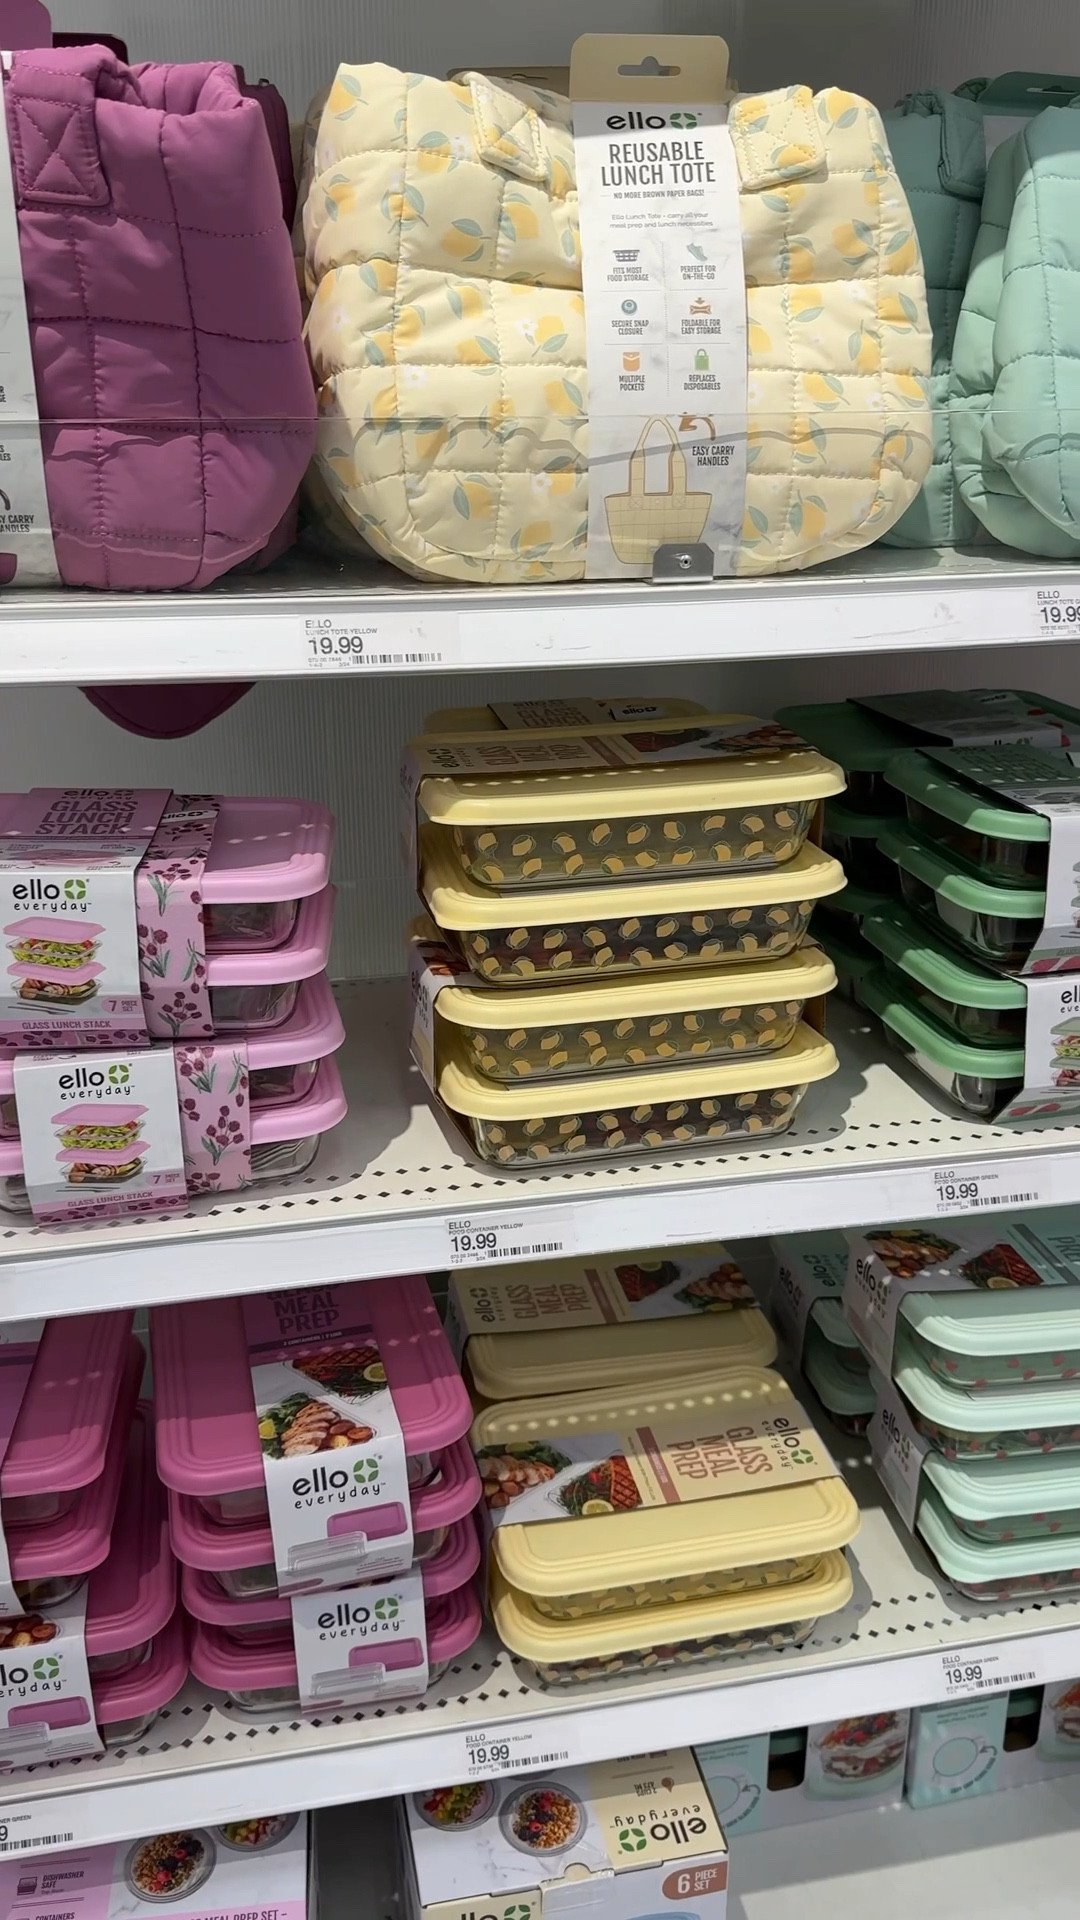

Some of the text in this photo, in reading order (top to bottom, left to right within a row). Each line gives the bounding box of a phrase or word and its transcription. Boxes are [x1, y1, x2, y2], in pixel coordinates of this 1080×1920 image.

[606, 112, 666, 130] ello
[609, 142, 705, 164] REUSABLE
[601, 162, 716, 187] LUNCH TOTE
[666, 190, 685, 198] PAPER
[686, 189, 705, 197] BAGS!
[646, 212, 662, 220] Tote
[627, 222, 643, 230] prep
[658, 220, 676, 228] lunch
[624, 274, 650, 282] STORAGE
[612, 320, 649, 328] SECURE SNAP
[681, 318, 721, 328] FOLDABLE FOR
[618, 328, 644, 336] CLOSURE
[681, 326, 722, 335] EASY STORAGE
[619, 375, 646, 384] MULTIPLE
[689, 374, 716, 383] REPLACES
[620, 383, 644, 392] POCKETS
[684, 382, 721, 391] DISPOSABLES
[692, 446, 734, 456] EASY CARRY
[697, 456, 730, 466] HANDLES
[8, 514, 34, 524] CARRY
[0, 524, 30, 532] ANDLES
[1037, 590, 1060, 600] ELLO
[306, 619, 332, 628] ELLO
[308, 636, 364, 654] 19.99
[522, 716, 593, 728] LUNCH
[64, 789, 109, 797] ello
[50, 800, 138, 812] GLASS
[41, 812, 135, 823] LUNCH
[35, 824, 129, 835] STACK
[12, 878, 60, 900] ello
[14, 901, 88, 912] everyday
[1060, 985, 1080, 1004] el
[108, 1000, 117, 1012] 7
[22, 1020, 112, 1030] GLASS LUNCH STACK
[59, 1068, 104, 1090] ello
[60, 1086, 132, 1100] everyday
[152, 1175, 161, 1184] 7
[934, 1171, 954, 1180] ELLO
[950, 1176, 980, 1184] CONTAINER
[936, 1182, 978, 1200] 19.99
[68, 1192, 153, 1208] GLASS LUNCH STACK
[448, 1220, 471, 1230] ELLO
[448, 1222, 523, 1236] FOOD CONTAINER YELLOW
[451, 1232, 496, 1252] 19.99
[856, 1258, 876, 1292] ello
[505, 1284, 540, 1320] GLASS
[532, 1284, 566, 1314] MEAL
[558, 1283, 593, 1312] PREP
[274, 1292, 340, 1318] MEAL
[474, 1299, 494, 1322] ello
[278, 1309, 340, 1334] PREP
[774, 1417, 800, 1448] ello
[882, 1409, 900, 1444] ello
[762, 1420, 790, 1468] everyday
[697, 1434, 740, 1478] MEAL
[726, 1426, 773, 1475] GLASS
[666, 1440, 708, 1480] PREP
[292, 1466, 349, 1496] ello
[295, 1484, 382, 1509] everyday
[318, 1603, 370, 1629] ello
[320, 1622, 401, 1641] everyday
[942, 1656, 960, 1664] ELLO
[957, 1659, 982, 1668] CONTAINER
[0, 1664, 28, 1686] lo
[945, 1666, 982, 1684] 19.99
[0, 1681, 62, 1698] eryday
[466, 1734, 486, 1744] ELLO
[482, 1738, 510, 1746] CONTAINER
[512, 1734, 532, 1742] YELLOW
[468, 1744, 510, 1765] 19.99
[12, 1814, 32, 1822] GREEN
[614, 1804, 701, 1827] everyday
[650, 1816, 707, 1844] ello
[43, 1870, 84, 1882] DISHWASHER
[694, 1868, 718, 1882] PIECE
[41, 1881, 57, 1889] SAFE
[678, 1874, 690, 1894] 6
[694, 1878, 711, 1891] SET
[36, 1912, 75, 1920] CONTAINERS
[261, 1910, 279, 1920] SET
